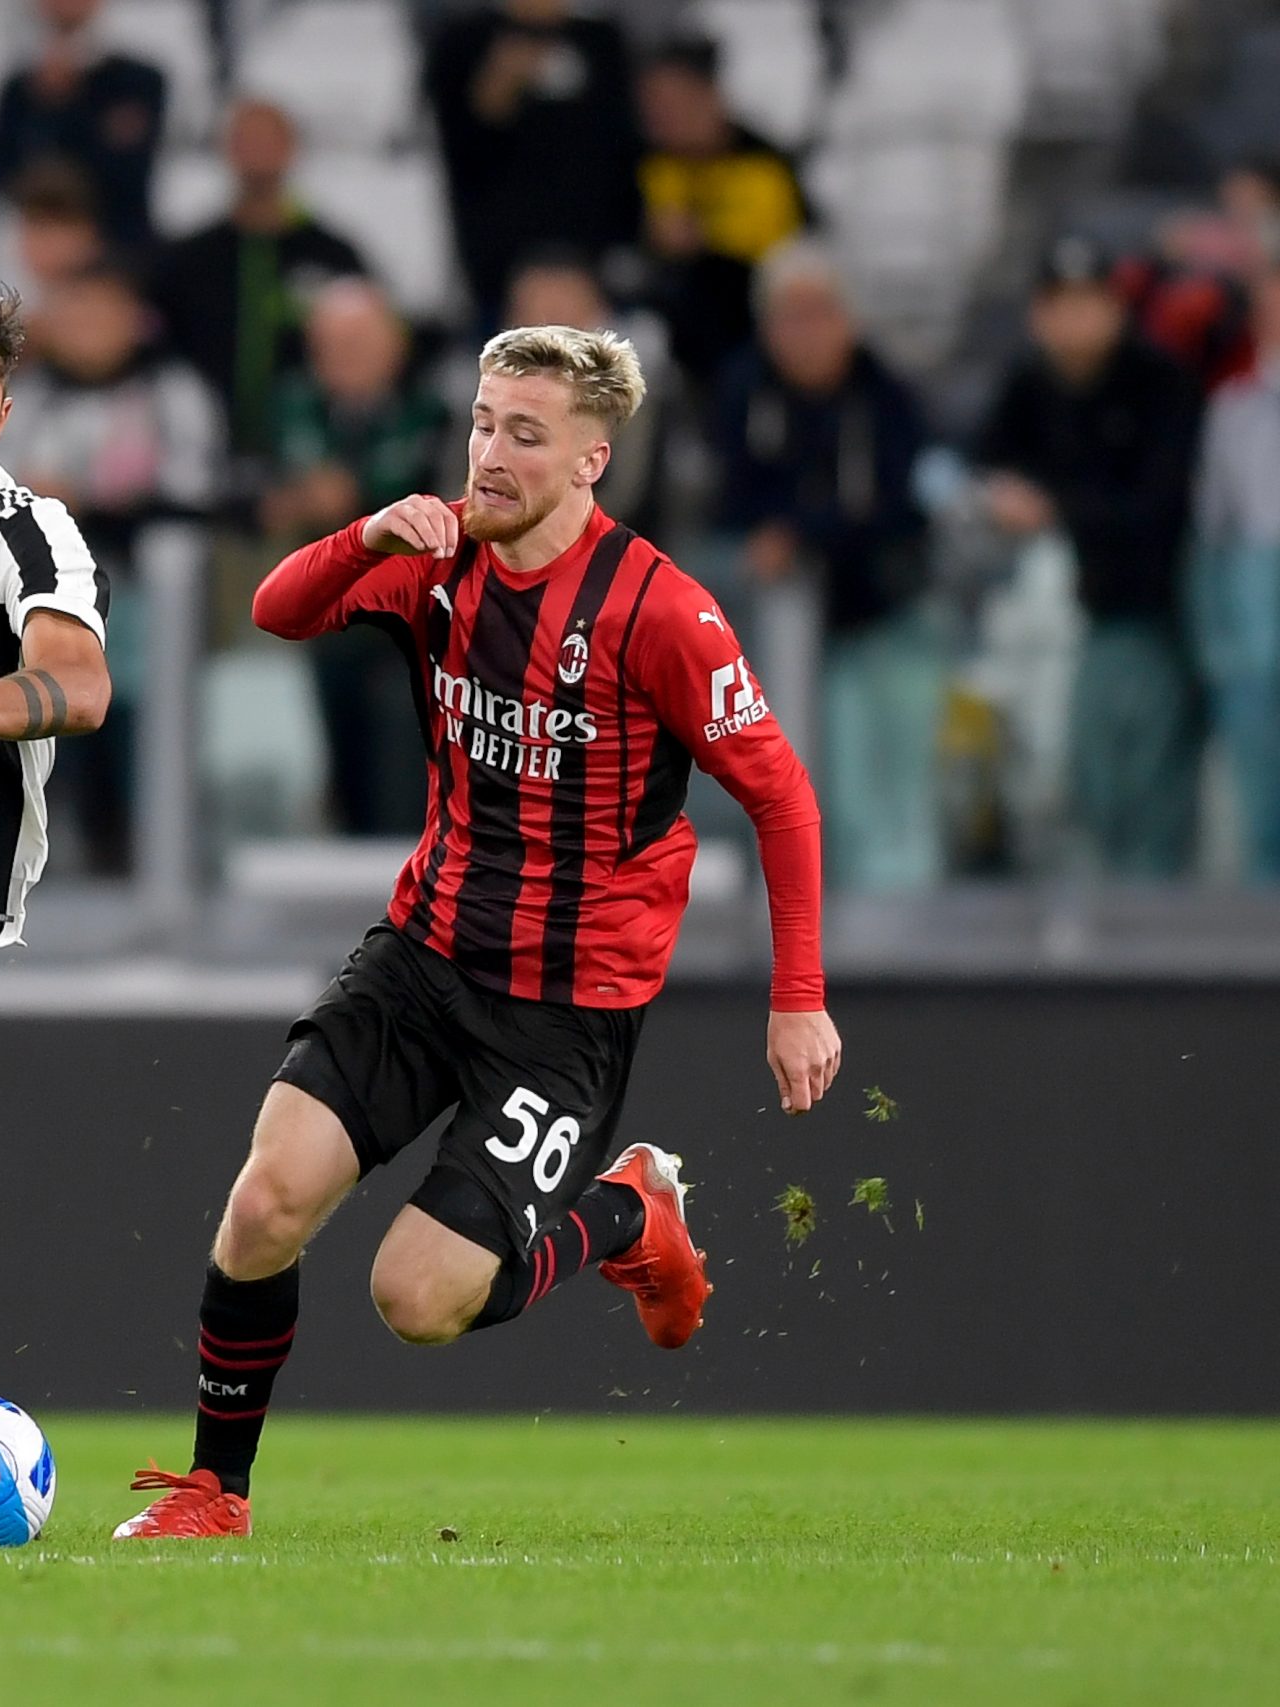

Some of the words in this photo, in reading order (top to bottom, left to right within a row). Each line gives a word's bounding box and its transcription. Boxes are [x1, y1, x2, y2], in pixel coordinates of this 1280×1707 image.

[429, 652, 598, 743] mirates
[703, 695, 770, 743] BitMEX
[439, 704, 464, 748] LY
[470, 727, 562, 781] BETTER
[484, 1086, 580, 1193] 56
[198, 1373, 248, 1396] ACM
